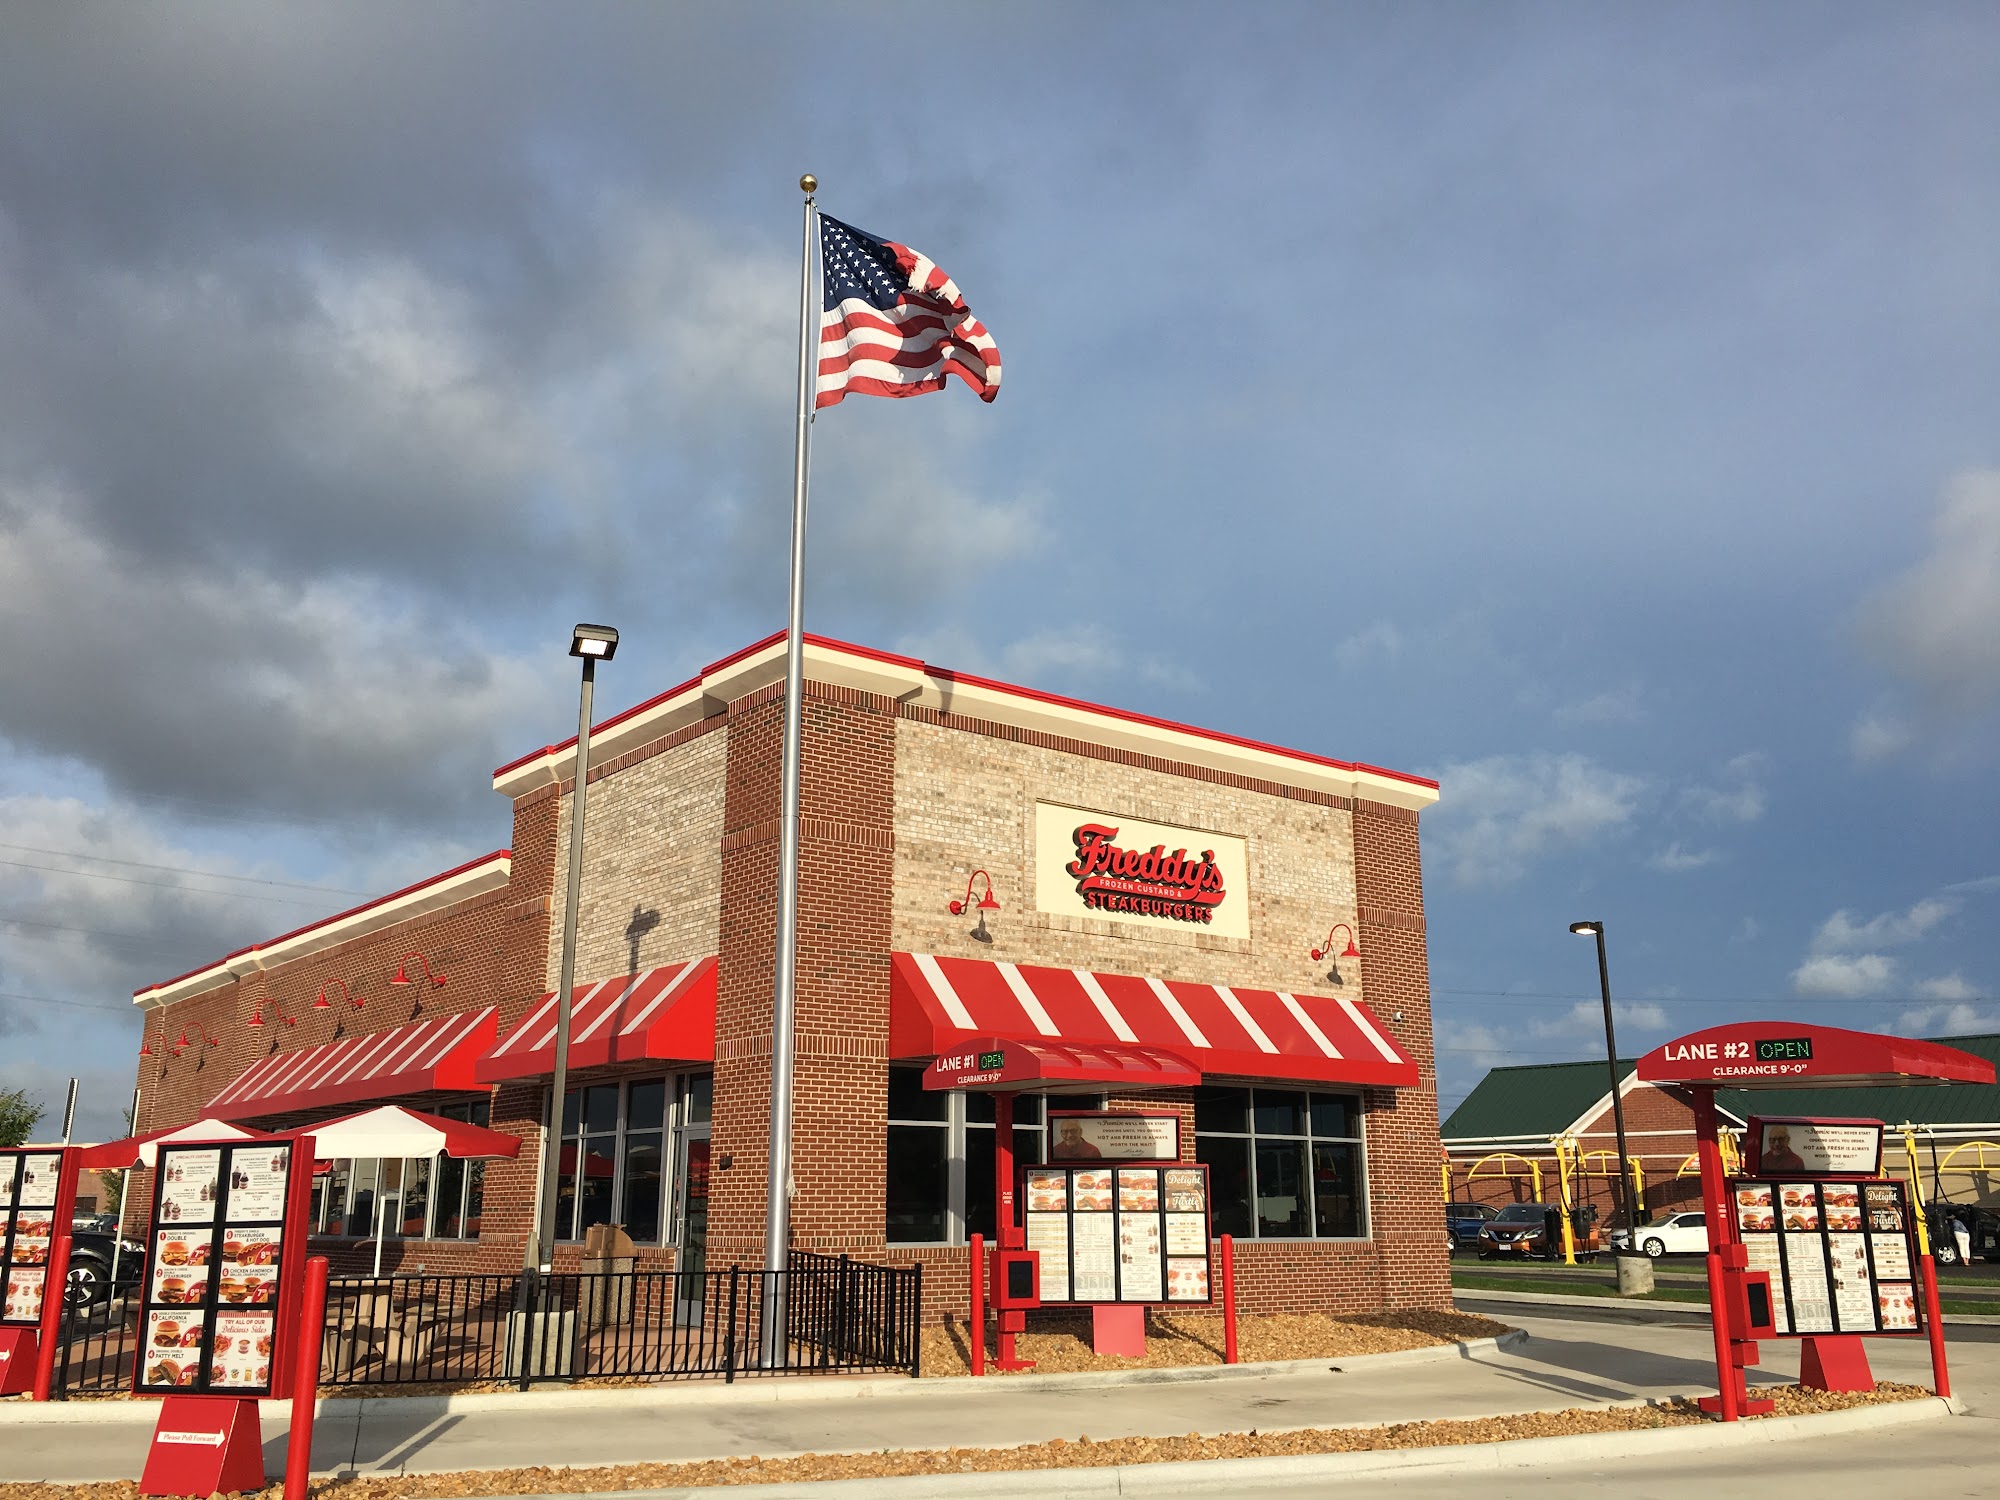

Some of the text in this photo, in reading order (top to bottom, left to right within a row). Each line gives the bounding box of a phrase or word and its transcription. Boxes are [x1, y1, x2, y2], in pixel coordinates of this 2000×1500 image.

[1067, 823, 1224, 893] Freddy's
[1099, 879, 1182, 898] FROZEN CUSTARD &
[1087, 892, 1213, 921] STEAKBURGERS
[1664, 1042, 1750, 1061] LANE #2
[1760, 1041, 1810, 1059] OPEN
[936, 1054, 974, 1073] LANE #1
[981, 1053, 1004, 1069] OPEN
[1712, 1064, 1778, 1076] CLEARANCE
[957, 1073, 988, 1084] CLEARANCE
[1168, 1175, 1201, 1186] Delight
[1172, 1197, 1200, 1206] Turtle
[1868, 1191, 1898, 1204] Delight
[1873, 1215, 1898, 1225] Turtle
[222, 1325, 267, 1333] Delicious Sides
[193, 1434, 216, 1442] Forward
